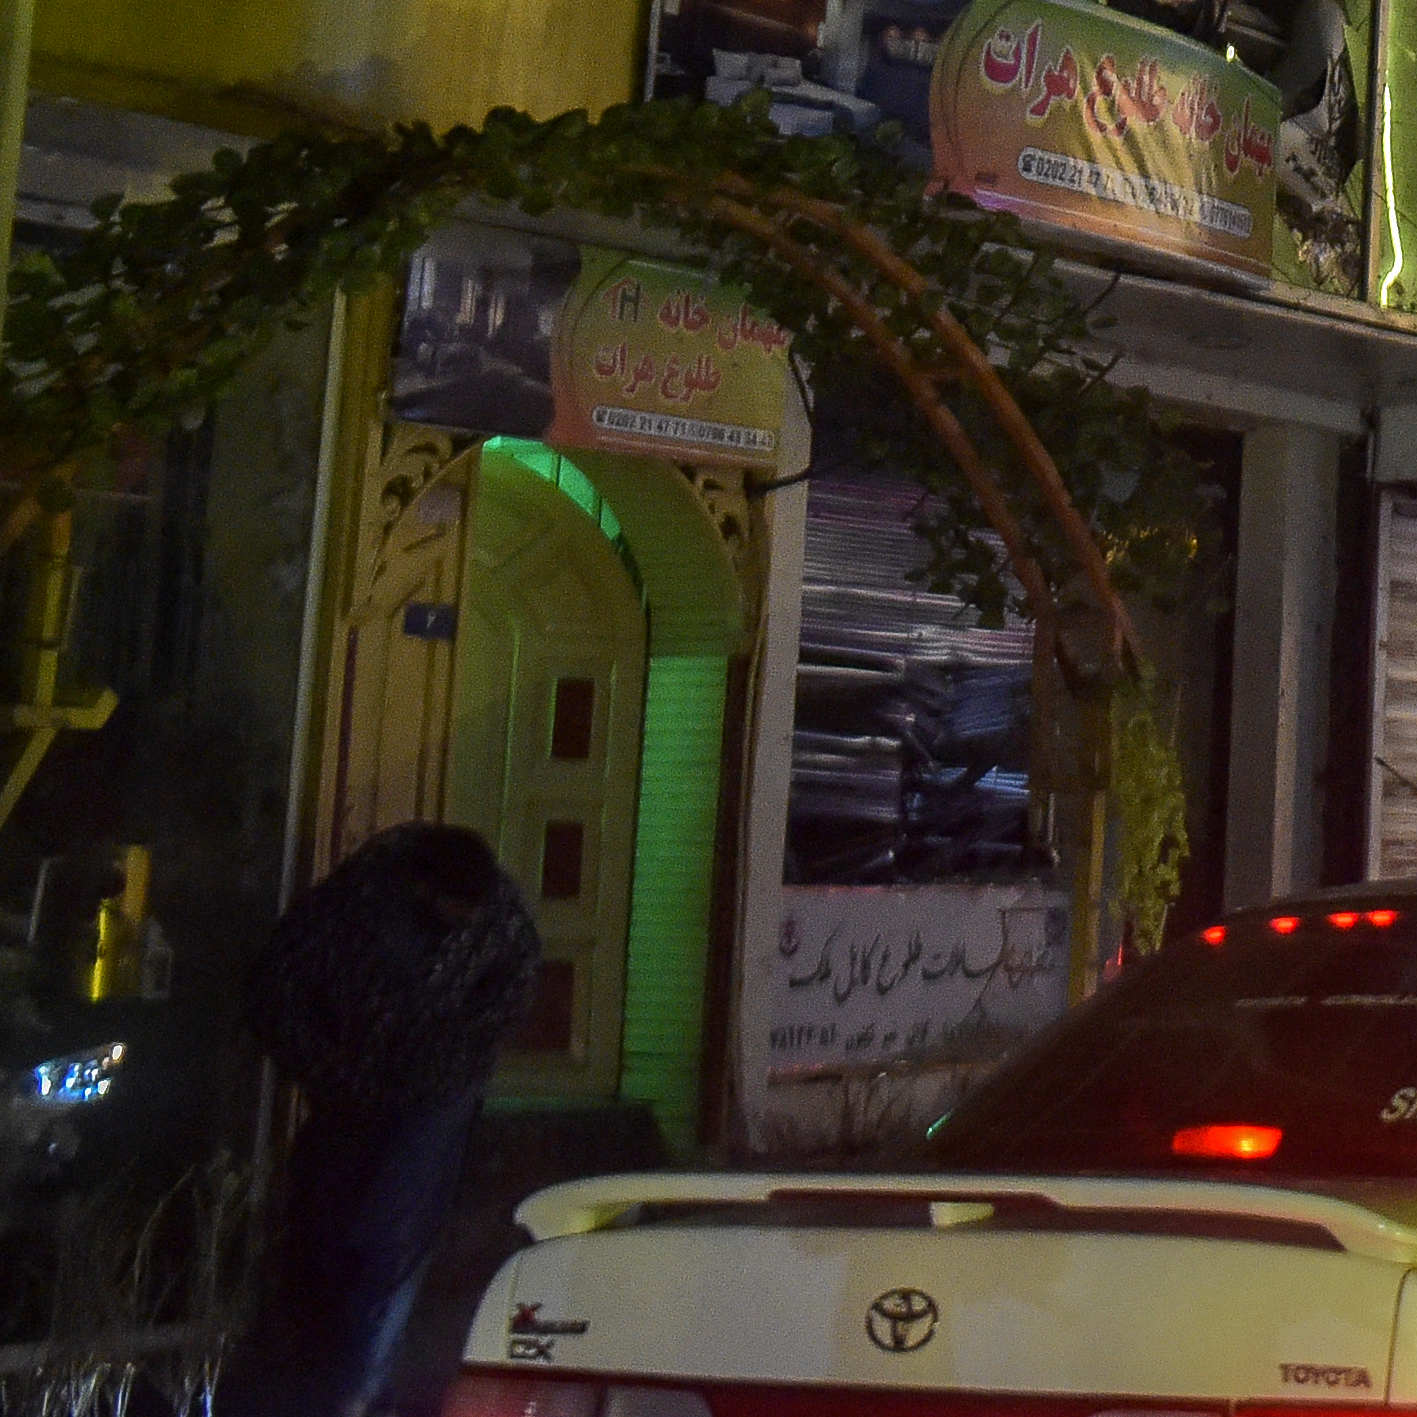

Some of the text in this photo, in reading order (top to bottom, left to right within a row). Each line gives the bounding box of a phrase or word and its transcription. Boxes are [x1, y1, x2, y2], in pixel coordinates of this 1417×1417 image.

[982, 19, 1078, 118] هرات
[1085, 55, 1167, 137] طلوع
[594, 342, 722, 402] طلوع هرات
[1279, 1364, 1371, 1389] TOYOTA
